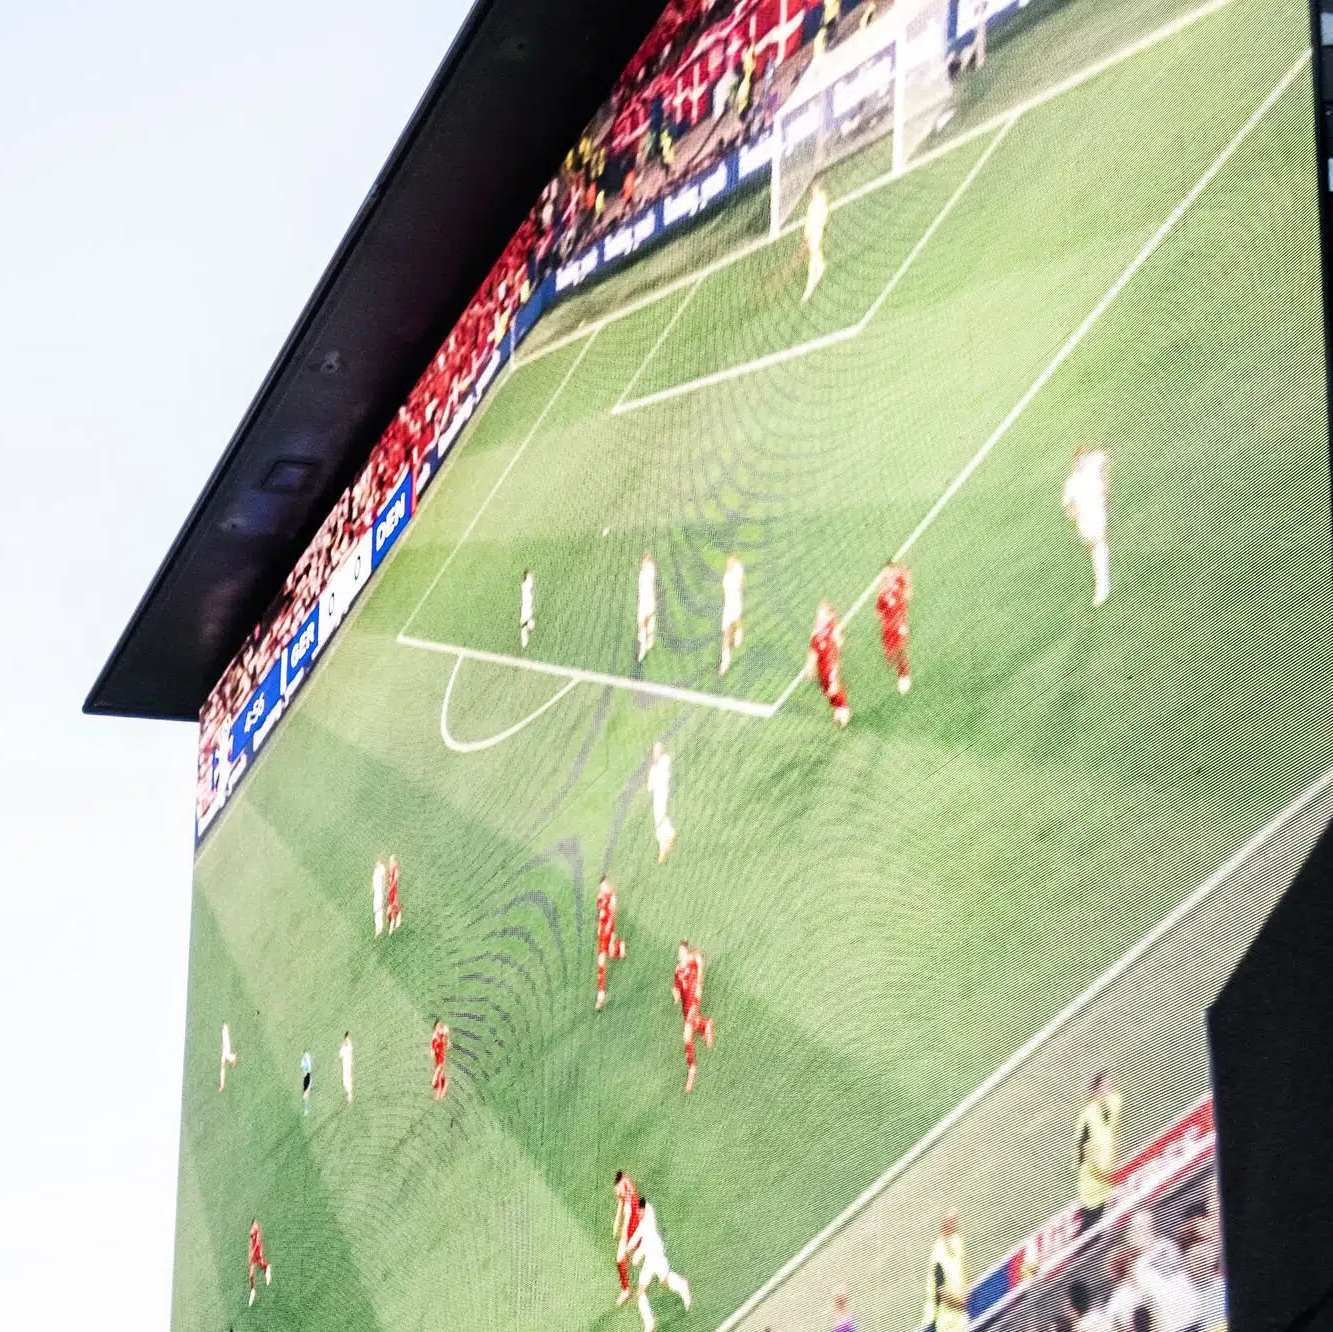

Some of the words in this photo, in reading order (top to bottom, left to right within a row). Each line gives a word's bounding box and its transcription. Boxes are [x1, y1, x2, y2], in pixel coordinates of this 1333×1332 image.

[290, 620, 316, 668] GER
[353, 555, 362, 581] 0
[375, 491, 407, 552] DEN
